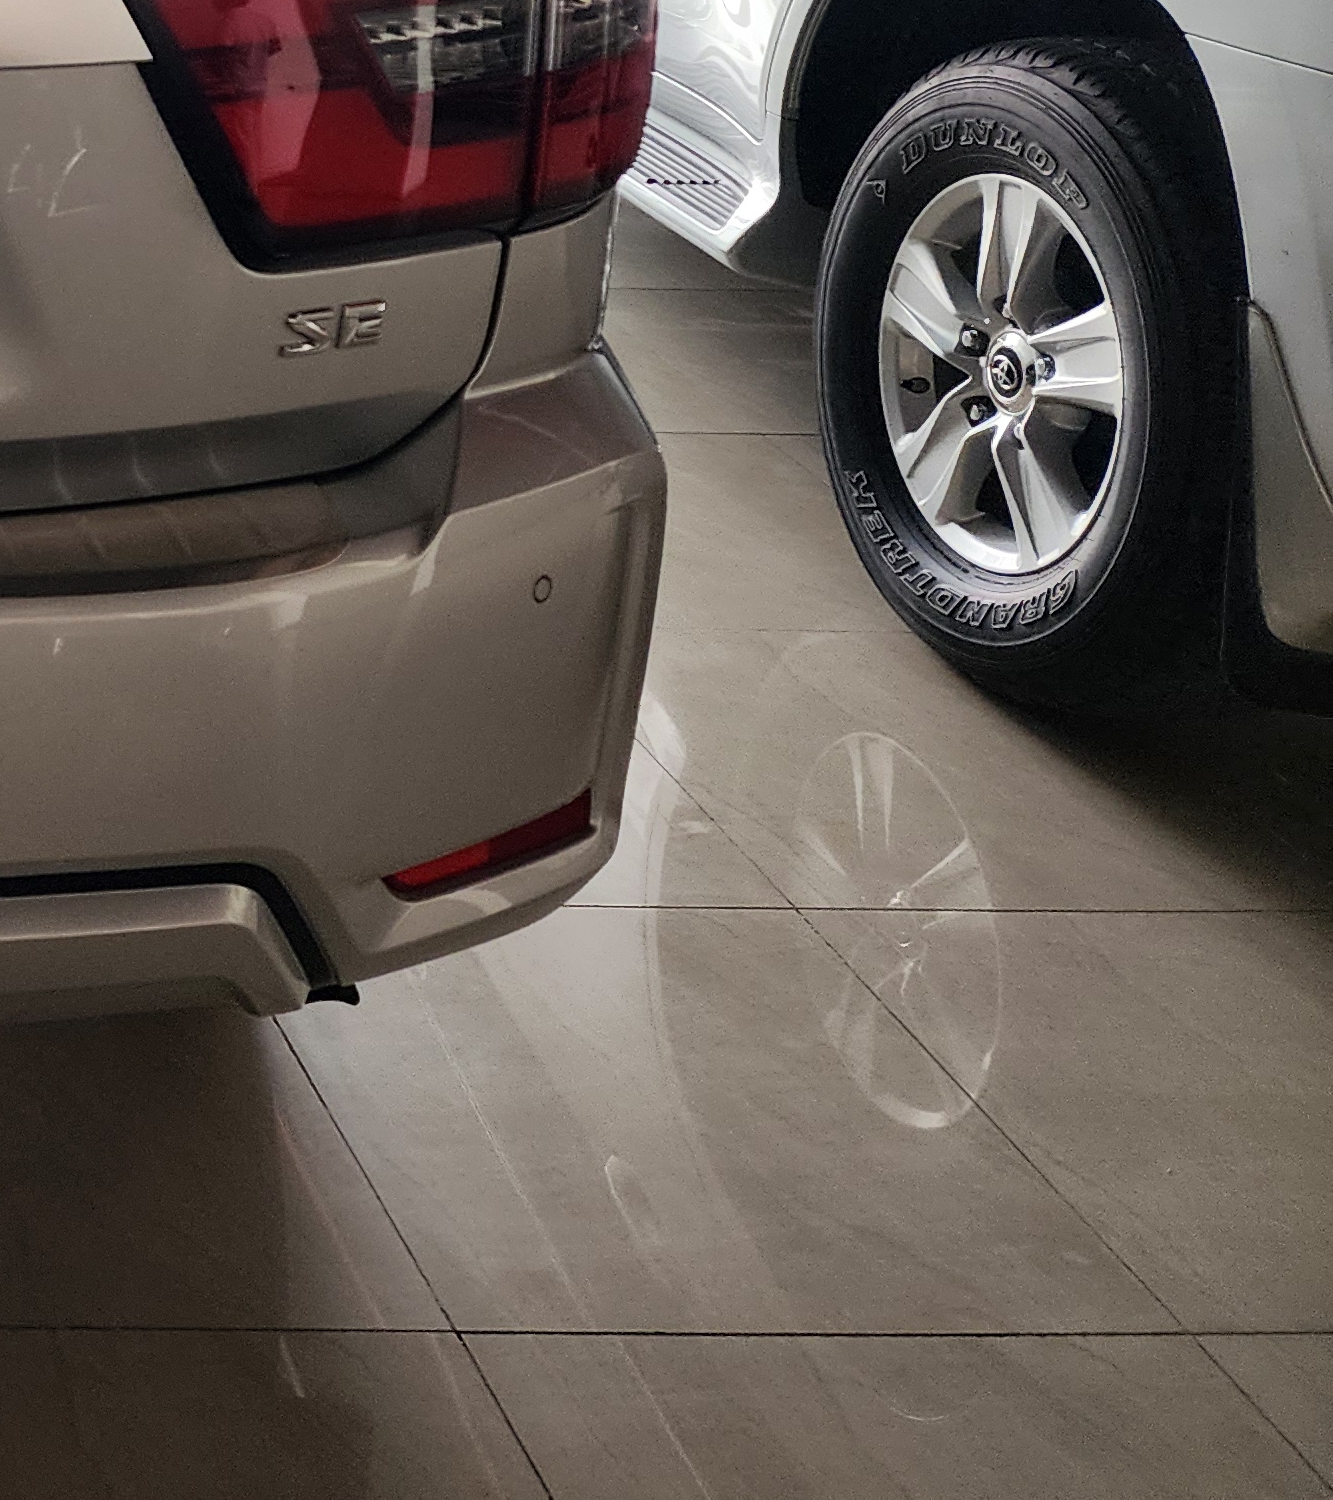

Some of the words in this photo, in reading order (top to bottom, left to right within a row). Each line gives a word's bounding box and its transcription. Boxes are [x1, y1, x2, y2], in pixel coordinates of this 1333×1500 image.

[899, 118, 1088, 210] DUNLOP
[278, 299, 386, 357] SE
[843, 469, 1081, 629] GRANDTREK
